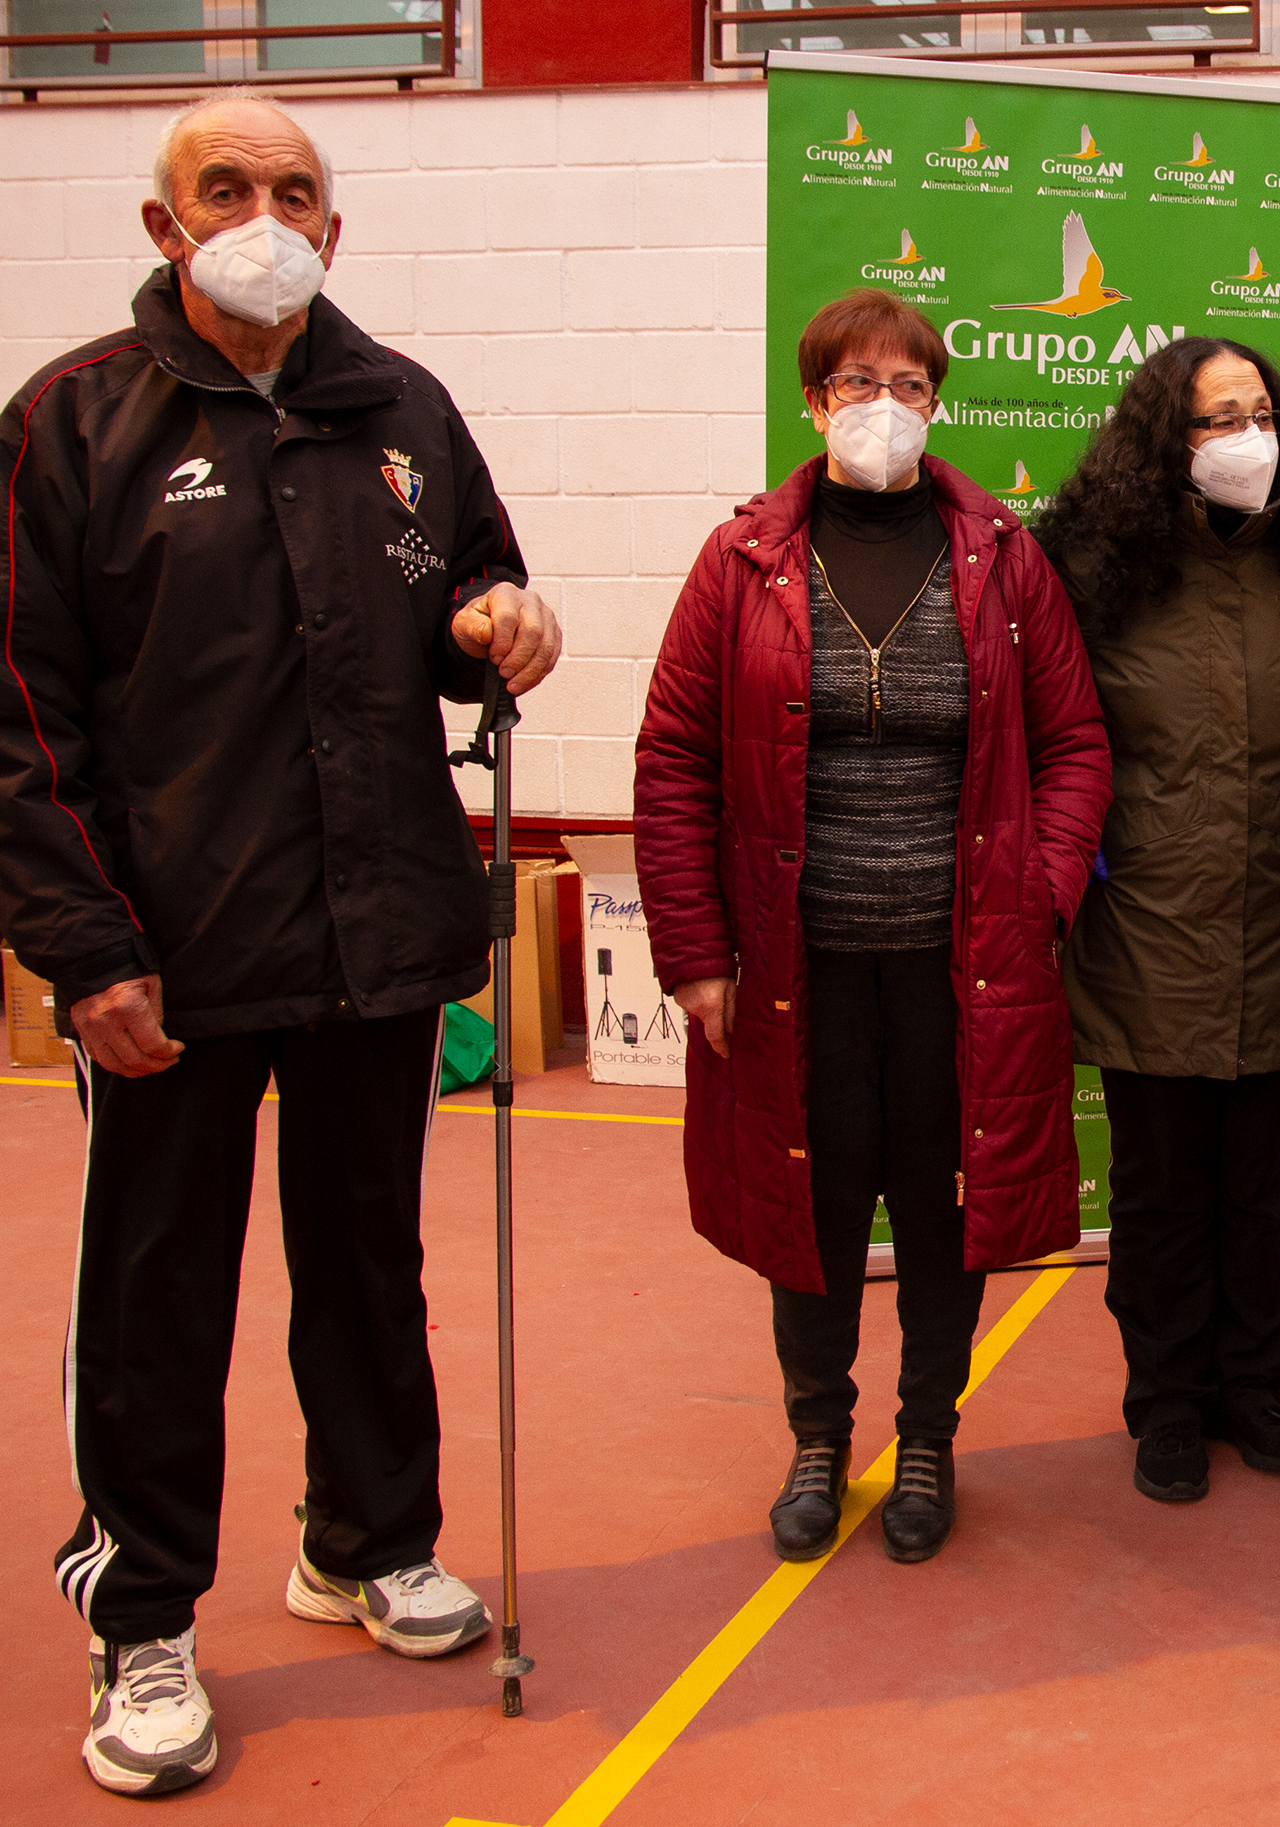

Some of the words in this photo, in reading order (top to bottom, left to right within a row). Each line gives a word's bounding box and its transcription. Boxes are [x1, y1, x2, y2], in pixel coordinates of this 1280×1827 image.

[806, 145, 860, 166] Grupo
[863, 148, 893, 165] AN
[925, 152, 978, 172] Grupo
[980, 155, 1009, 171] AN
[844, 162, 865, 170] DESDE
[962, 169, 983, 177] DESDE
[1041, 159, 1093, 179] Grupo
[1096, 162, 1124, 178] AN
[1154, 166, 1204, 186] Grupo
[1207, 169, 1235, 185] AN
[1077, 175, 1097, 183] DESDE
[860, 264, 914, 284] Grupo
[917, 266, 946, 282] AN
[1210, 280, 1260, 300] Grupo
[1245, 296, 1264, 304] DESDE
[943, 318, 1096, 375] Grupo
[1107, 323, 1185, 364] AN
[1051, 367, 1110, 386] DESDE
[967, 396, 990, 407] Más
[991, 397, 1003, 408] de
[1004, 398, 1025, 408] 100
[1027, 398, 1050, 409] años
[1051, 399, 1064, 409] de
[930, 401, 1100, 429] Alimentación
[164, 484, 227, 503] ASTORE
[385, 544, 447, 570] RESTAURA
[587, 893, 643, 922] Passp
[593, 1050, 661, 1065] Portable
[1077, 1089, 1105, 1102] Gru
